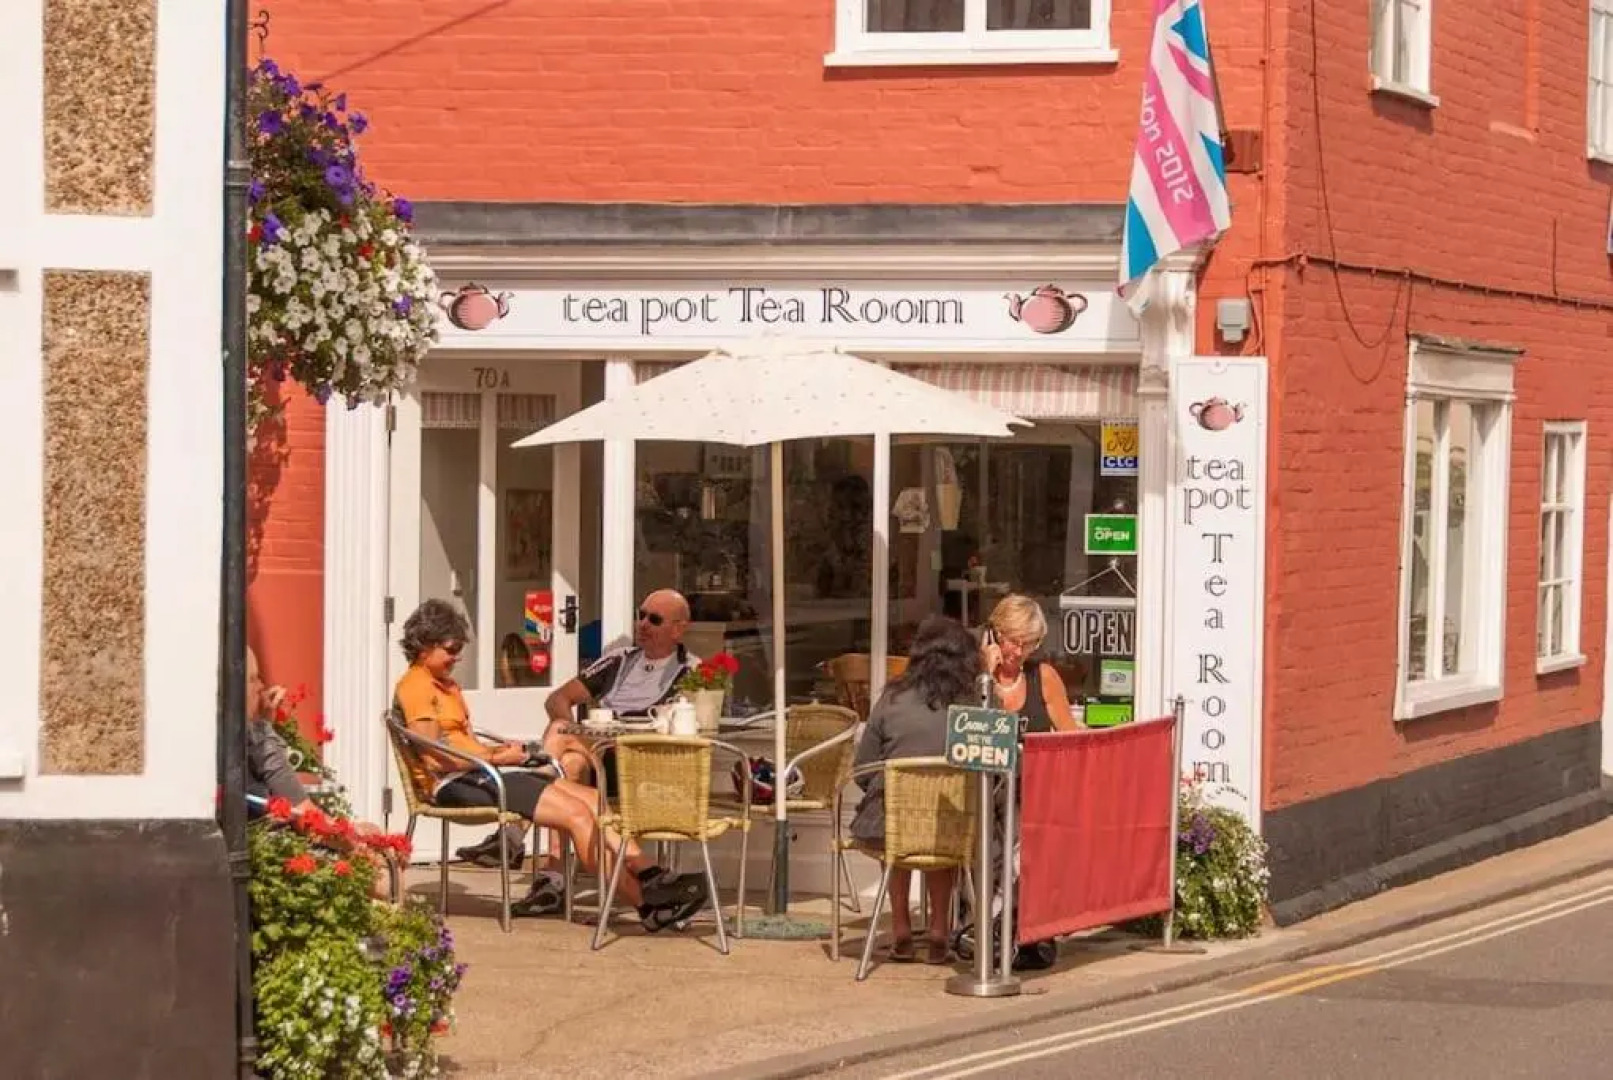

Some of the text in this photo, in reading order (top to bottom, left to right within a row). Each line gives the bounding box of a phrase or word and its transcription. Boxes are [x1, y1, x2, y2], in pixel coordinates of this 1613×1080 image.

[1155, 140, 1195, 204] 2012
[563, 287, 964, 336] tea pot Tea Room
[1186, 455, 1244, 481] tea
[1183, 484, 1251, 525] pot
[1093, 530, 1130, 541] OPEN
[1063, 609, 1135, 655] OPEN
[954, 712, 989, 733] Come
[951, 742, 1010, 766] OPEN
